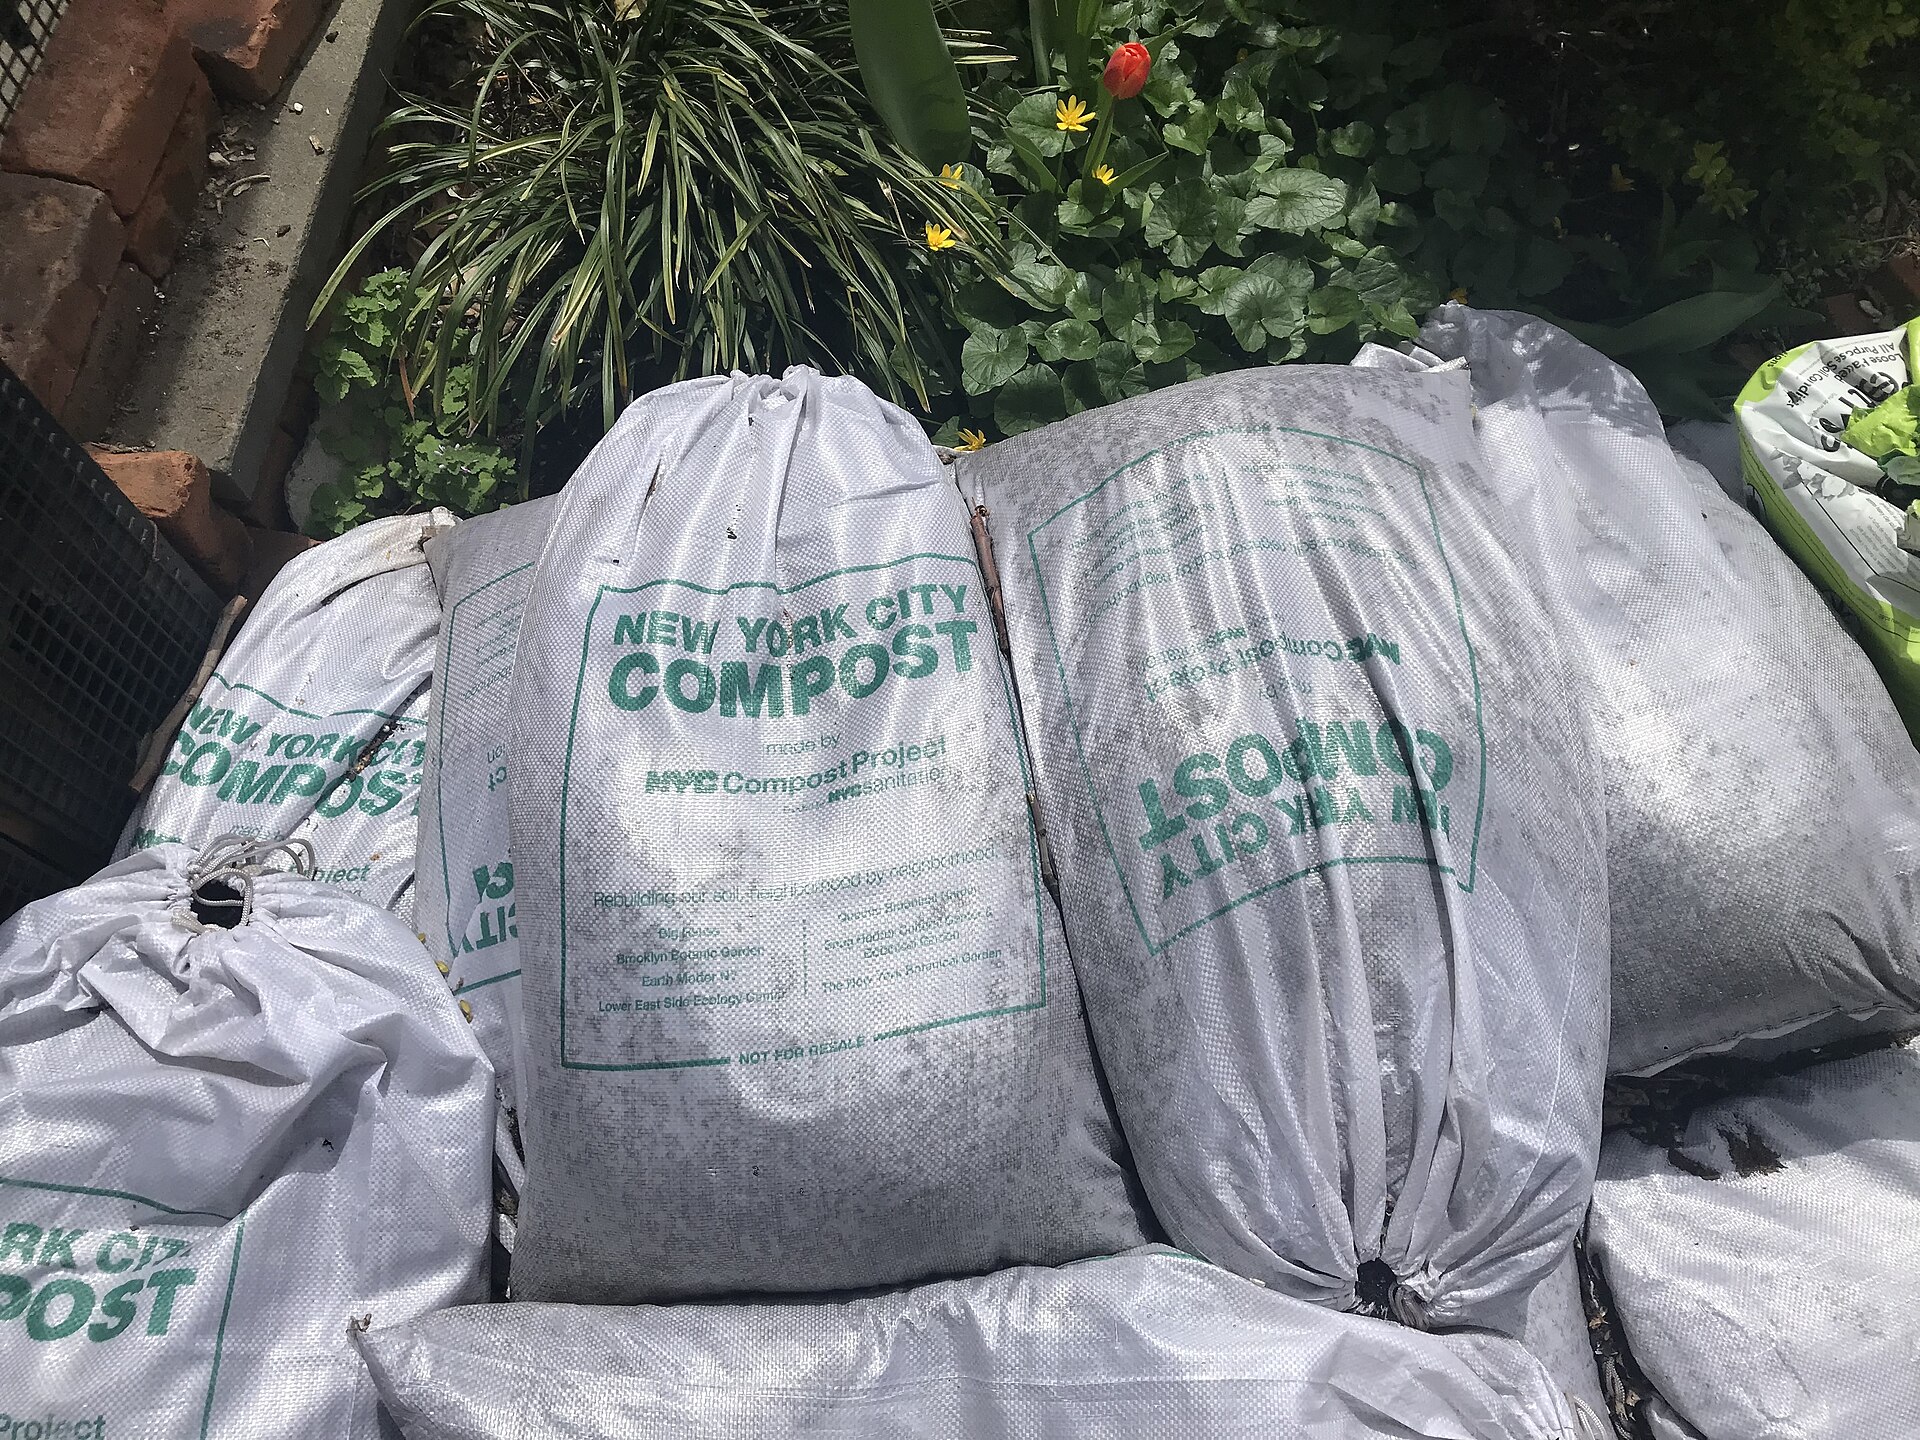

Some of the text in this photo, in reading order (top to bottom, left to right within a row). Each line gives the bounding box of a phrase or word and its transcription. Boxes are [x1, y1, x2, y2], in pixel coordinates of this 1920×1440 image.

[613, 584, 968, 657] NEW YORK CITY
[608, 620, 977, 718] COMPOST
[264, 732, 368, 766] YORK
[820, 732, 842, 749] by
[723, 761, 848, 795] Compost
[852, 735, 945, 774] Project
[1160, 813, 1268, 899] CITY
[599, 1000, 633, 1013] Lower
[635, 998, 661, 1011] East
[664, 996, 689, 1009] Side
[739, 1034, 865, 1064] NOT FOR RESALE
